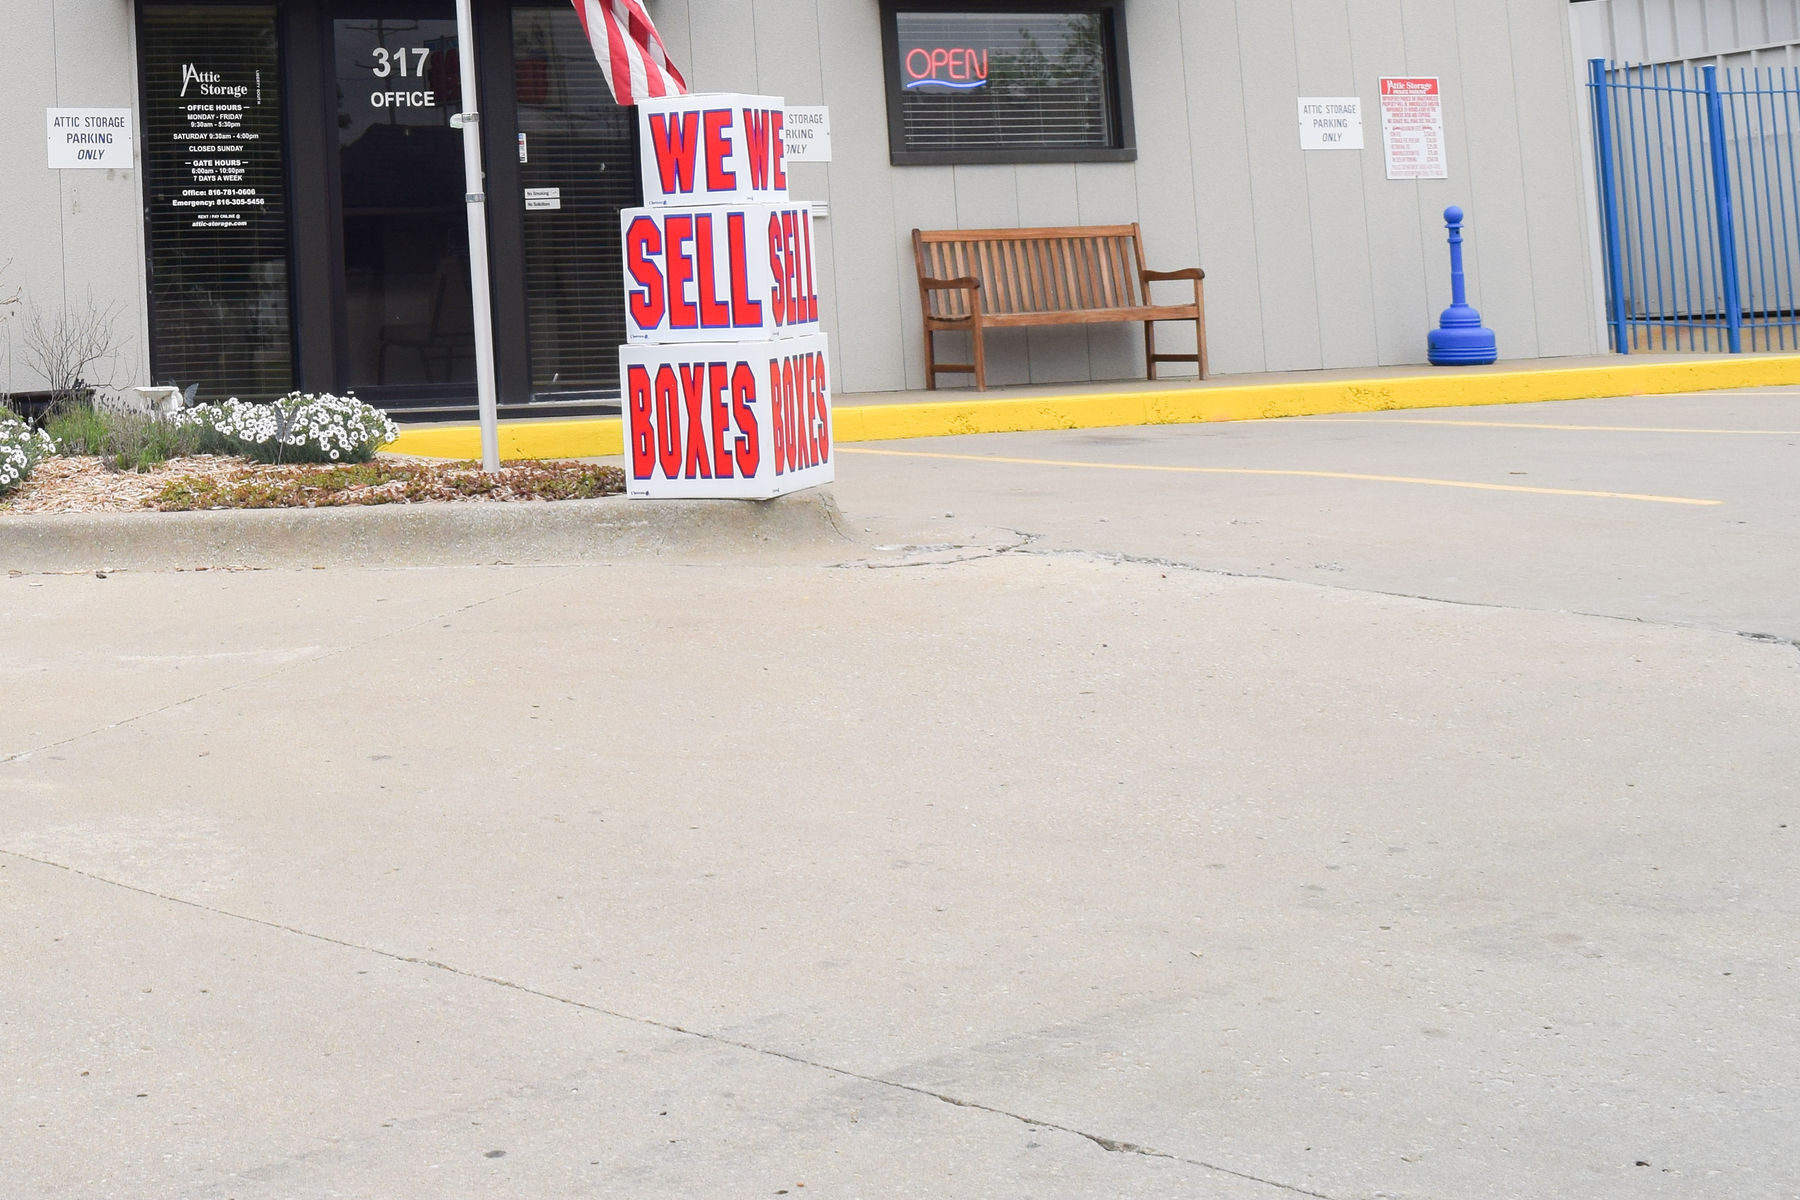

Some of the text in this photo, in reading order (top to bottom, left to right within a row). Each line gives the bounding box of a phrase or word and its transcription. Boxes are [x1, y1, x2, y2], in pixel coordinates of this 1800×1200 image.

[372, 47, 430, 77] 317
[906, 48, 988, 80] OPEN
[180, 62, 220, 97] Attic
[200, 84, 248, 98] Storage
[370, 91, 436, 108] OFFICE
[1304, 104, 1356, 114] ATTIC STORAGE
[54, 117, 125, 127] ATTIC STORAGE
[789, 114, 823, 124] STORAGE
[1313, 119, 1347, 128] PARKING
[66, 133, 113, 144] PARKING
[1322, 133, 1342, 142] ONLY
[78, 150, 105, 160] ONLY
[648, 108, 737, 194] WE
[742, 108, 787, 191] WE
[626, 211, 763, 330] SELL
[768, 209, 819, 327] SELL
[627, 361, 760, 479] BOXES
[769, 351, 829, 476] BOXES
